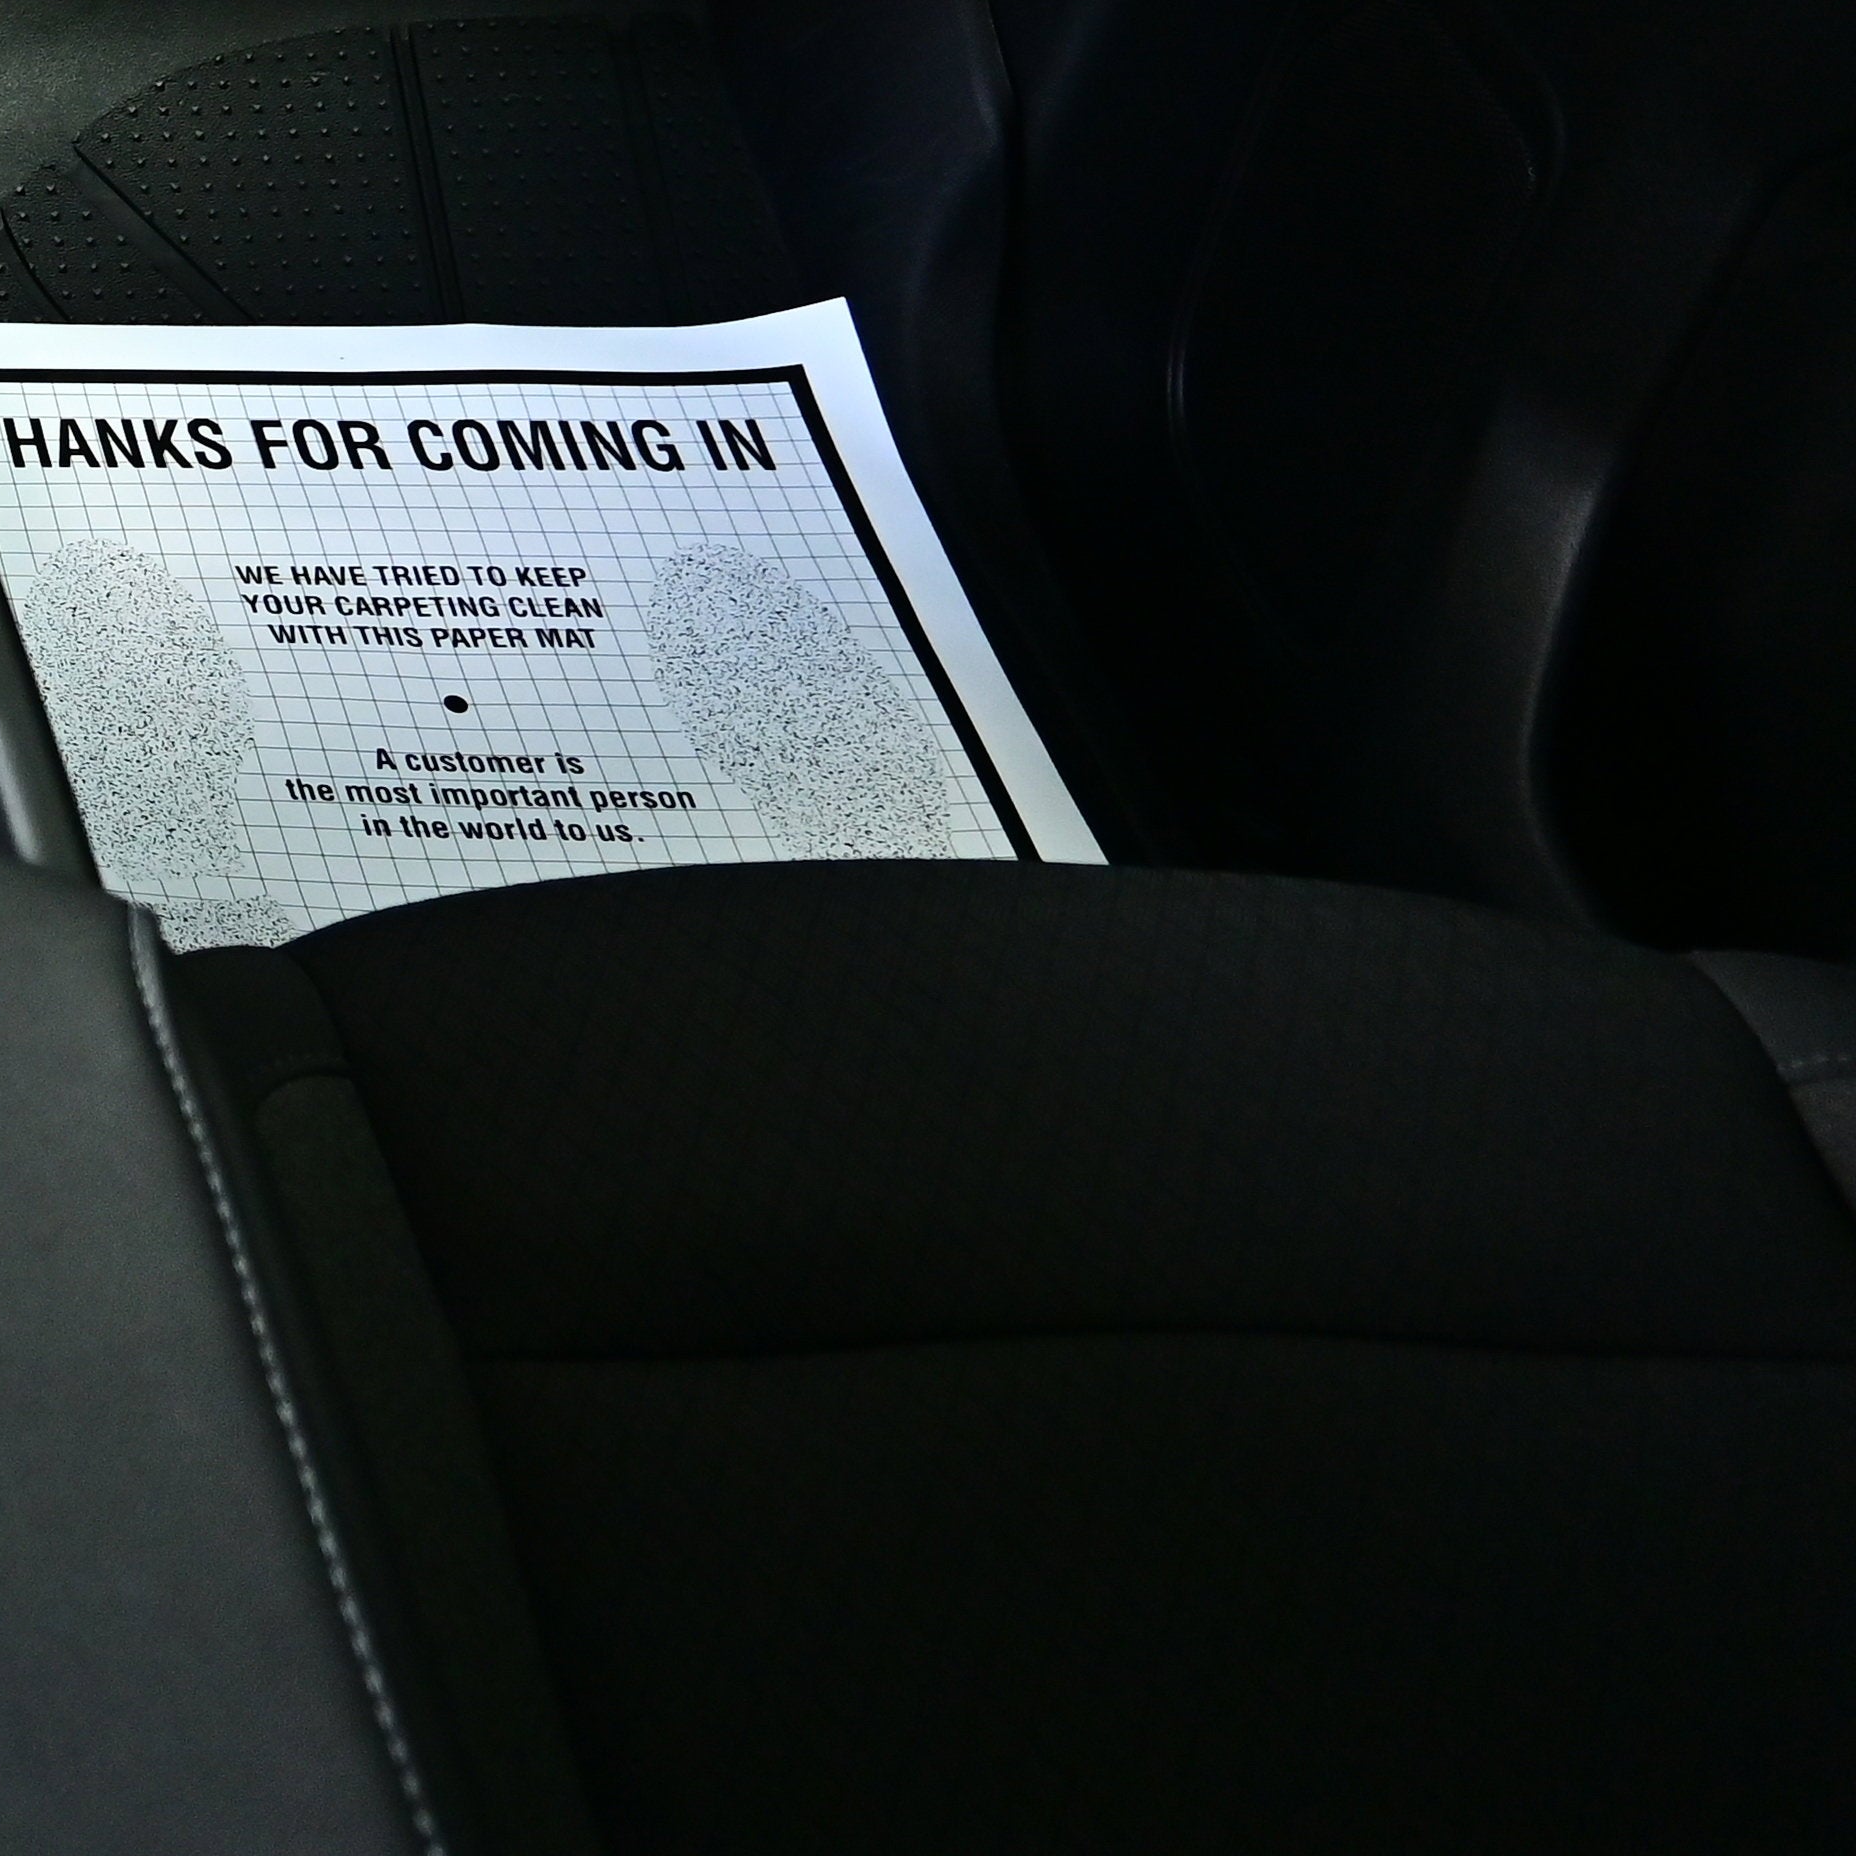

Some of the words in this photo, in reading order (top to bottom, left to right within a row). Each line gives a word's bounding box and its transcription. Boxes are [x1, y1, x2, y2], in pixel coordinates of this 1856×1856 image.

[251, 418, 393, 472] FOR
[408, 417, 687, 474] COMING
[696, 418, 779, 472] IN
[236, 565, 283, 585] WE
[290, 566, 367, 586] HAVE
[373, 566, 461, 587] TRIED
[467, 566, 507, 587] TO
[515, 566, 587, 588] KEEP
[242, 594, 326, 616] YOUR
[338, 595, 500, 618] CARPETING
[508, 596, 604, 619] CLEAN
[268, 624, 347, 645] WITH
[353, 625, 423, 648] THIS
[431, 627, 528, 649] PAPER
[537, 628, 597, 649] MAT
[376, 748, 397, 771] A
[406, 751, 545, 774] customer
[556, 752, 585, 775] is
[285, 778, 335, 802] the
[345, 782, 422, 805] most
[429, 782, 582, 811] important
[589, 789, 696, 813] person
[361, 813, 391, 837] in
[399, 815, 450, 839] the
[457, 817, 548, 841] world
[554, 820, 587, 842] to
[595, 822, 645, 843] us.
